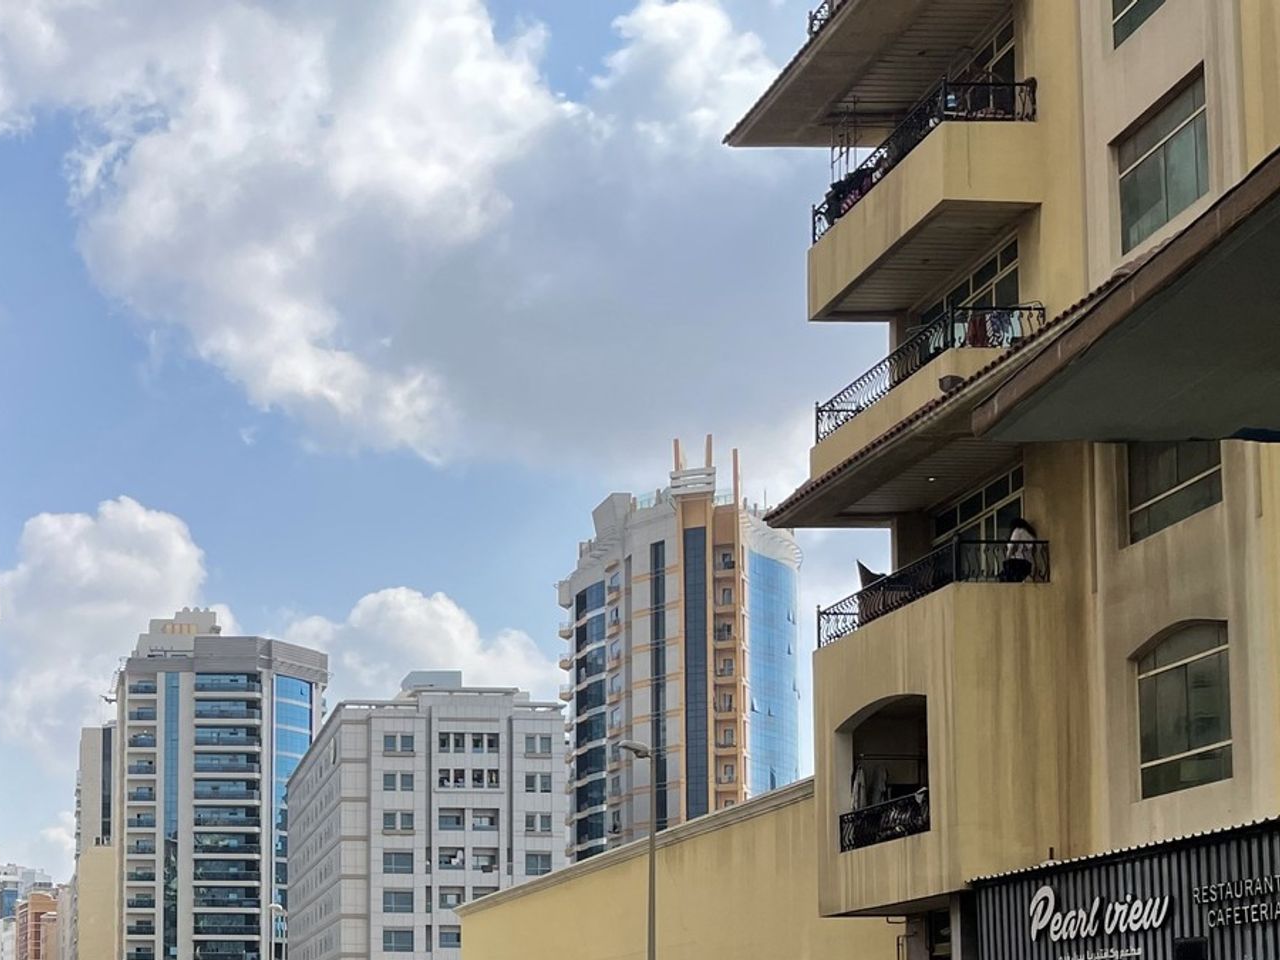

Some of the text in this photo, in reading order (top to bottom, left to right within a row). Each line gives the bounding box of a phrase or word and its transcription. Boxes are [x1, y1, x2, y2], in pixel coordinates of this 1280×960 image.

[1192, 874, 1280, 905] RESTAURANT
[1029, 885, 1169, 942] Pearl view
[1207, 901, 1280, 928] CAFETERIA
